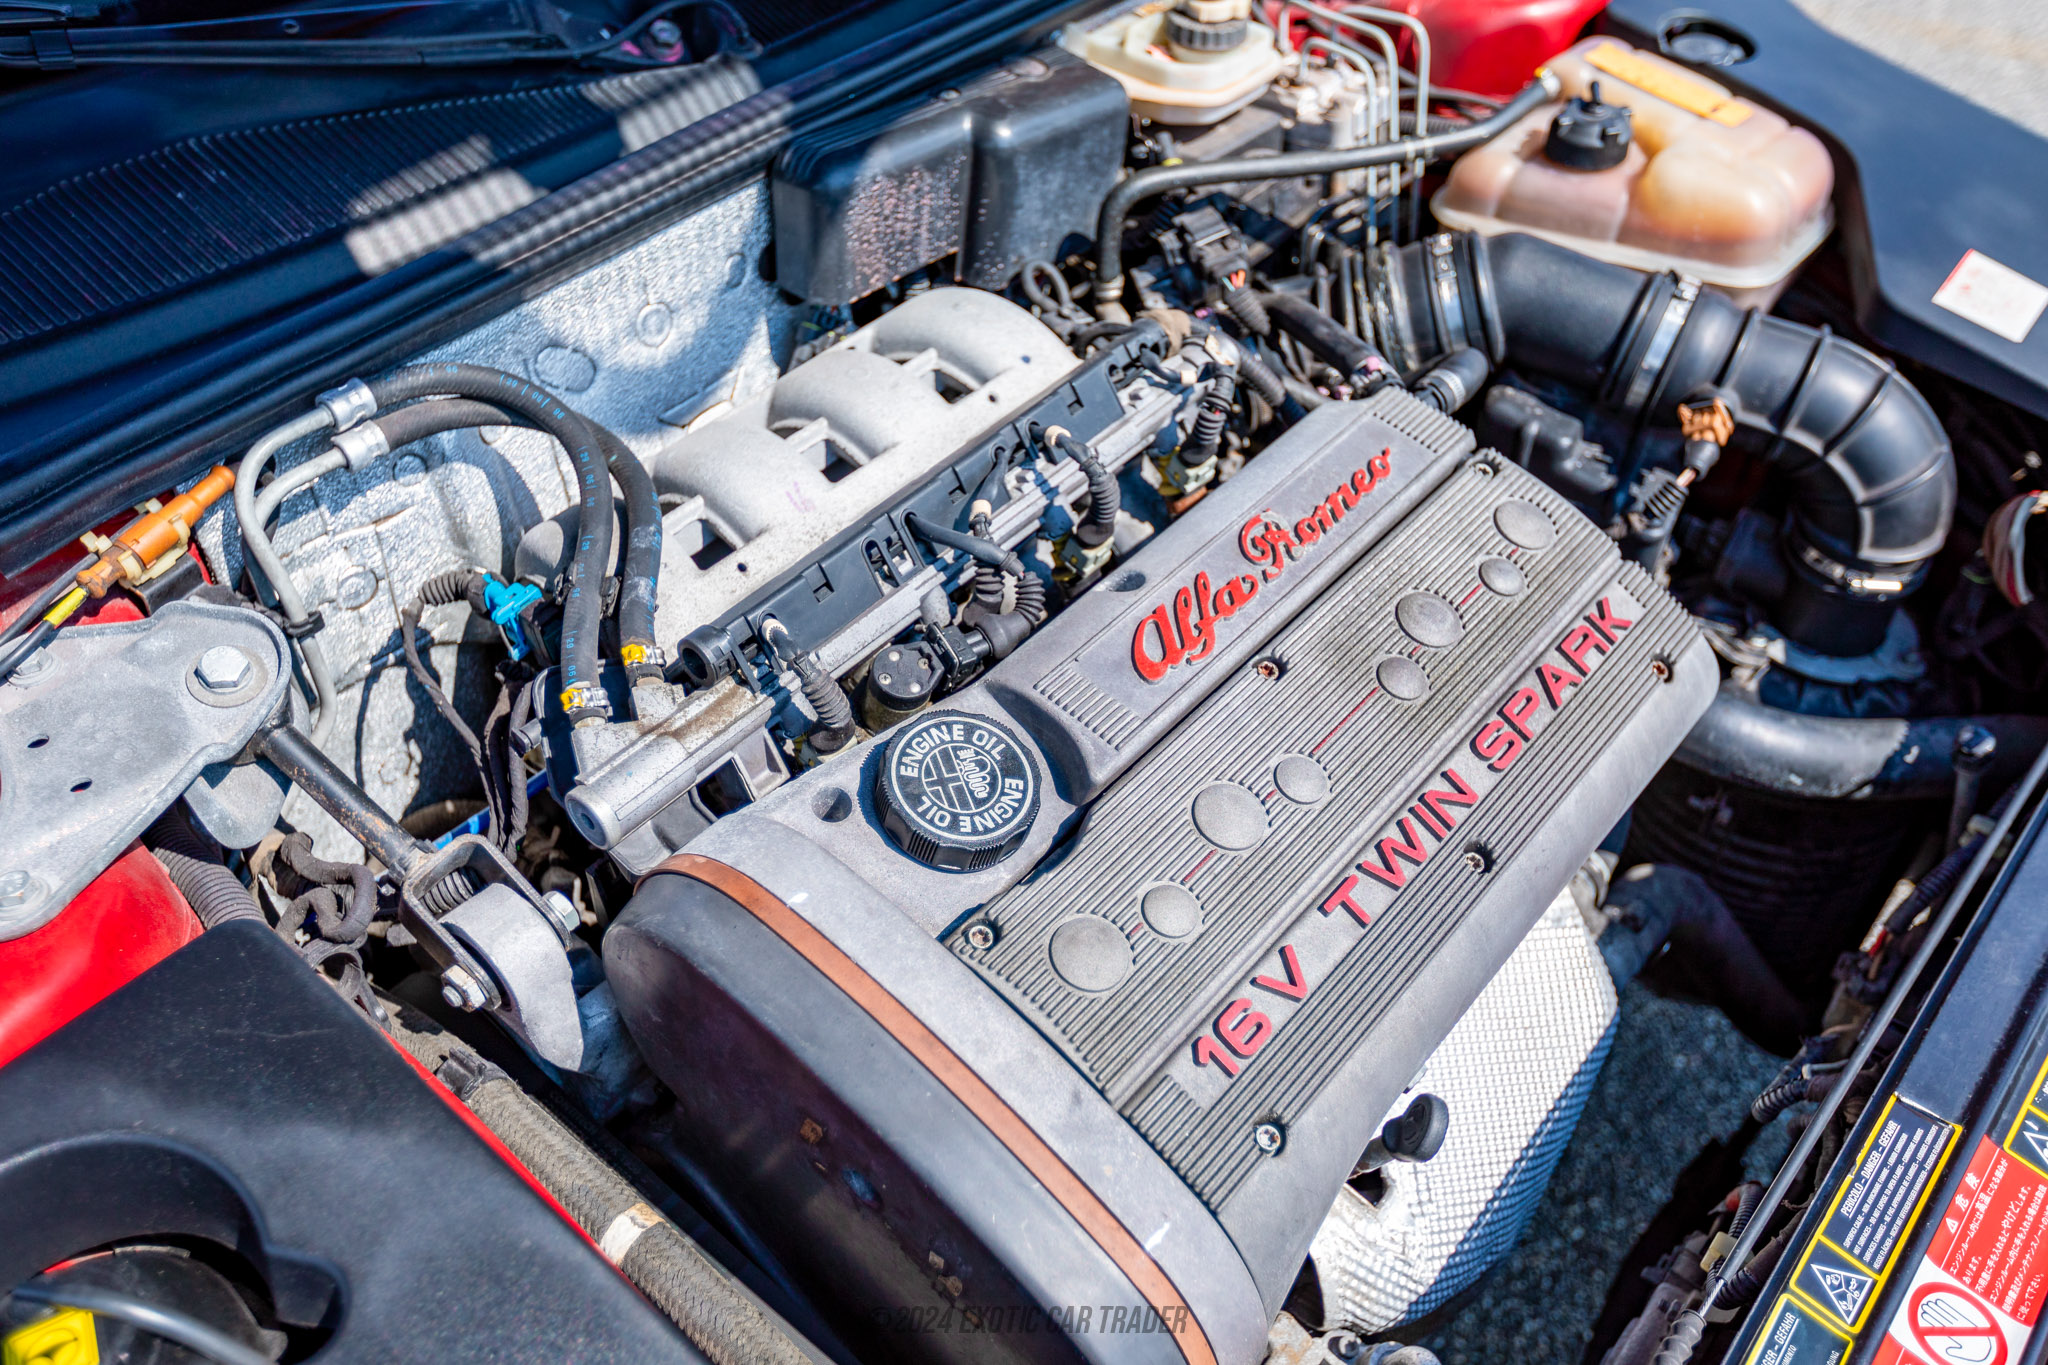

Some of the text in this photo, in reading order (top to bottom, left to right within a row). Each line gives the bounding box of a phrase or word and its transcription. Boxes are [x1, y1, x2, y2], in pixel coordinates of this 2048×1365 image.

[1131, 446, 1392, 682] Alfa Romeo
[899, 724, 1006, 777] ENGINE OIL
[1320, 768, 1480, 927] TWIN
[1474, 597, 1633, 770] SPARK
[917, 778, 1024, 833] ENGINE OIL
[1841, 1182, 1864, 1217] PERICOLO
[1861, 1150, 1881, 1179] DANGER
[1878, 1119, 1897, 1147] GEFAHR
[1774, 1312, 1796, 1345] GEFAHR
